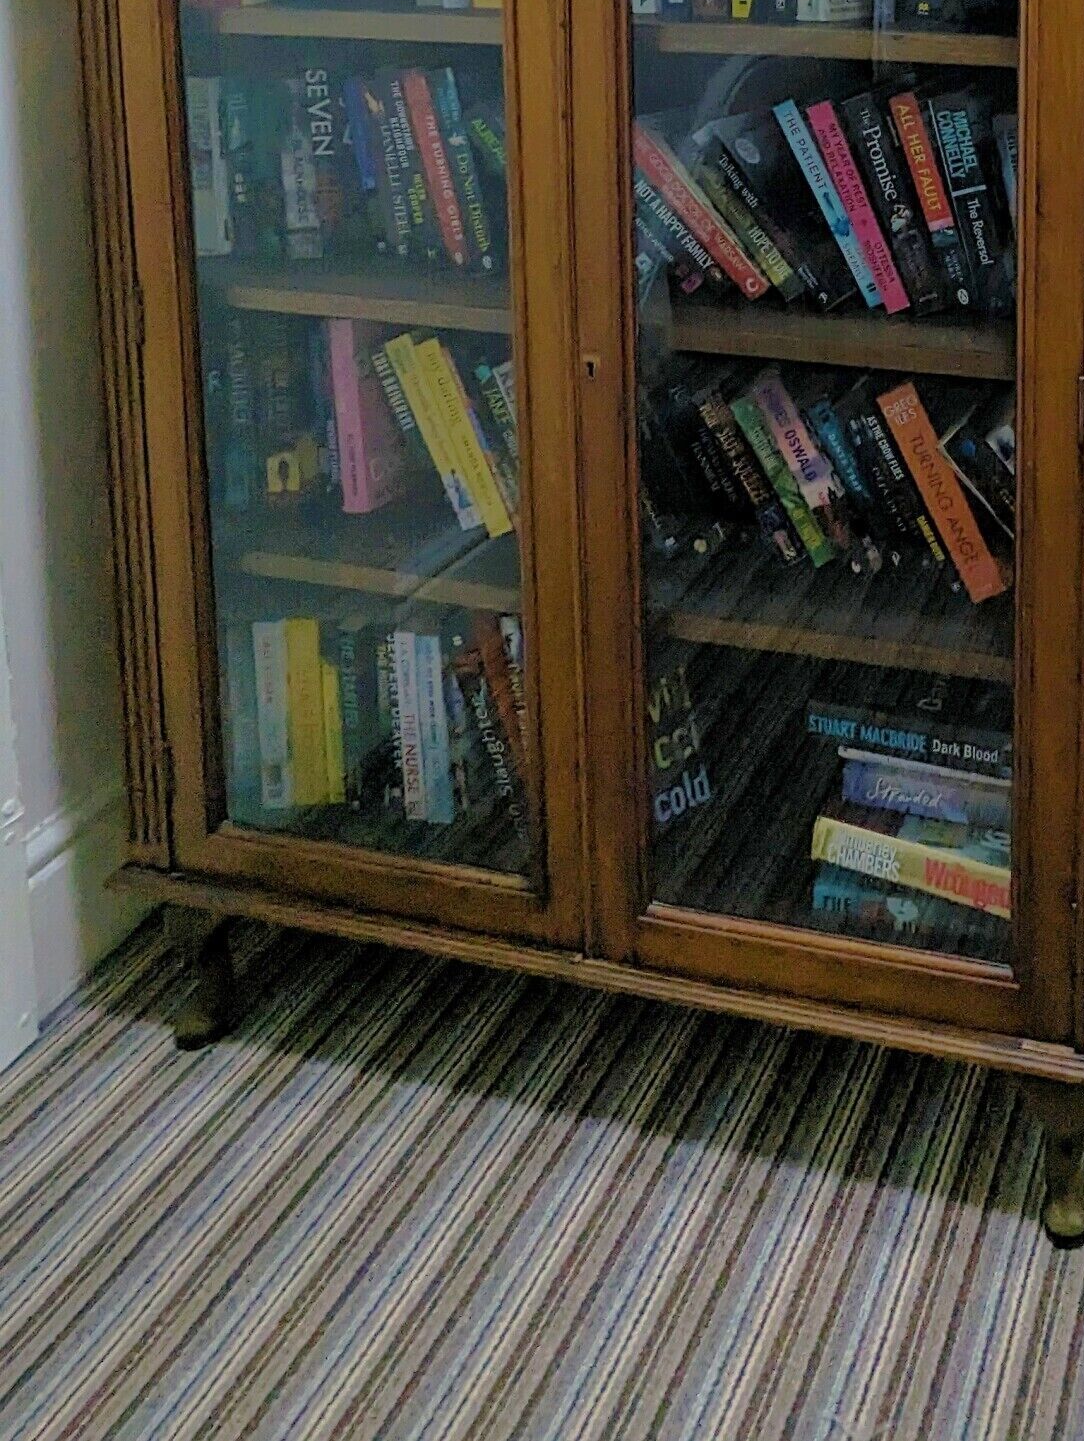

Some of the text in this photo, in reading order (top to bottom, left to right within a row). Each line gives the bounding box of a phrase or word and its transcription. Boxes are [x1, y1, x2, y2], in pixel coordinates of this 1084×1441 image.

[305, 68, 335, 156] SEVEN
[783, 111, 801, 137] THE
[795, 136, 827, 193] PATIENT
[827, 122, 868, 210] MY YEAR OF REST
[861, 124, 905, 202] Promise
[896, 103, 942, 213] ALL HER FAULT
[934, 109, 967, 180] CONNELLY
[950, 109, 982, 173] MICHAEL
[429, 142, 455, 200] BURNING
[632, 179, 657, 205] NOT
[713, 154, 762, 209] Talking with
[454, 152, 492, 253] Do Not Disturb
[648, 198, 662, 211] A
[654, 204, 687, 240] HAPPY
[680, 233, 714, 271] FAMILY
[746, 224, 774, 254] HOPE
[763, 248, 782, 267] TO
[965, 198, 994, 266] The Reversal
[865, 414, 878, 427] AS
[870, 424, 885, 441] THE
[780, 428, 821, 484] OSWALD
[877, 438, 895, 462] CROW
[888, 458, 905, 481] FLIES
[906, 432, 957, 513] TURNING
[808, 713, 1000, 765] STUART MACBRIDE Dark Blood
[403, 742, 421, 794] NURSE
[653, 764, 713, 823] cold
